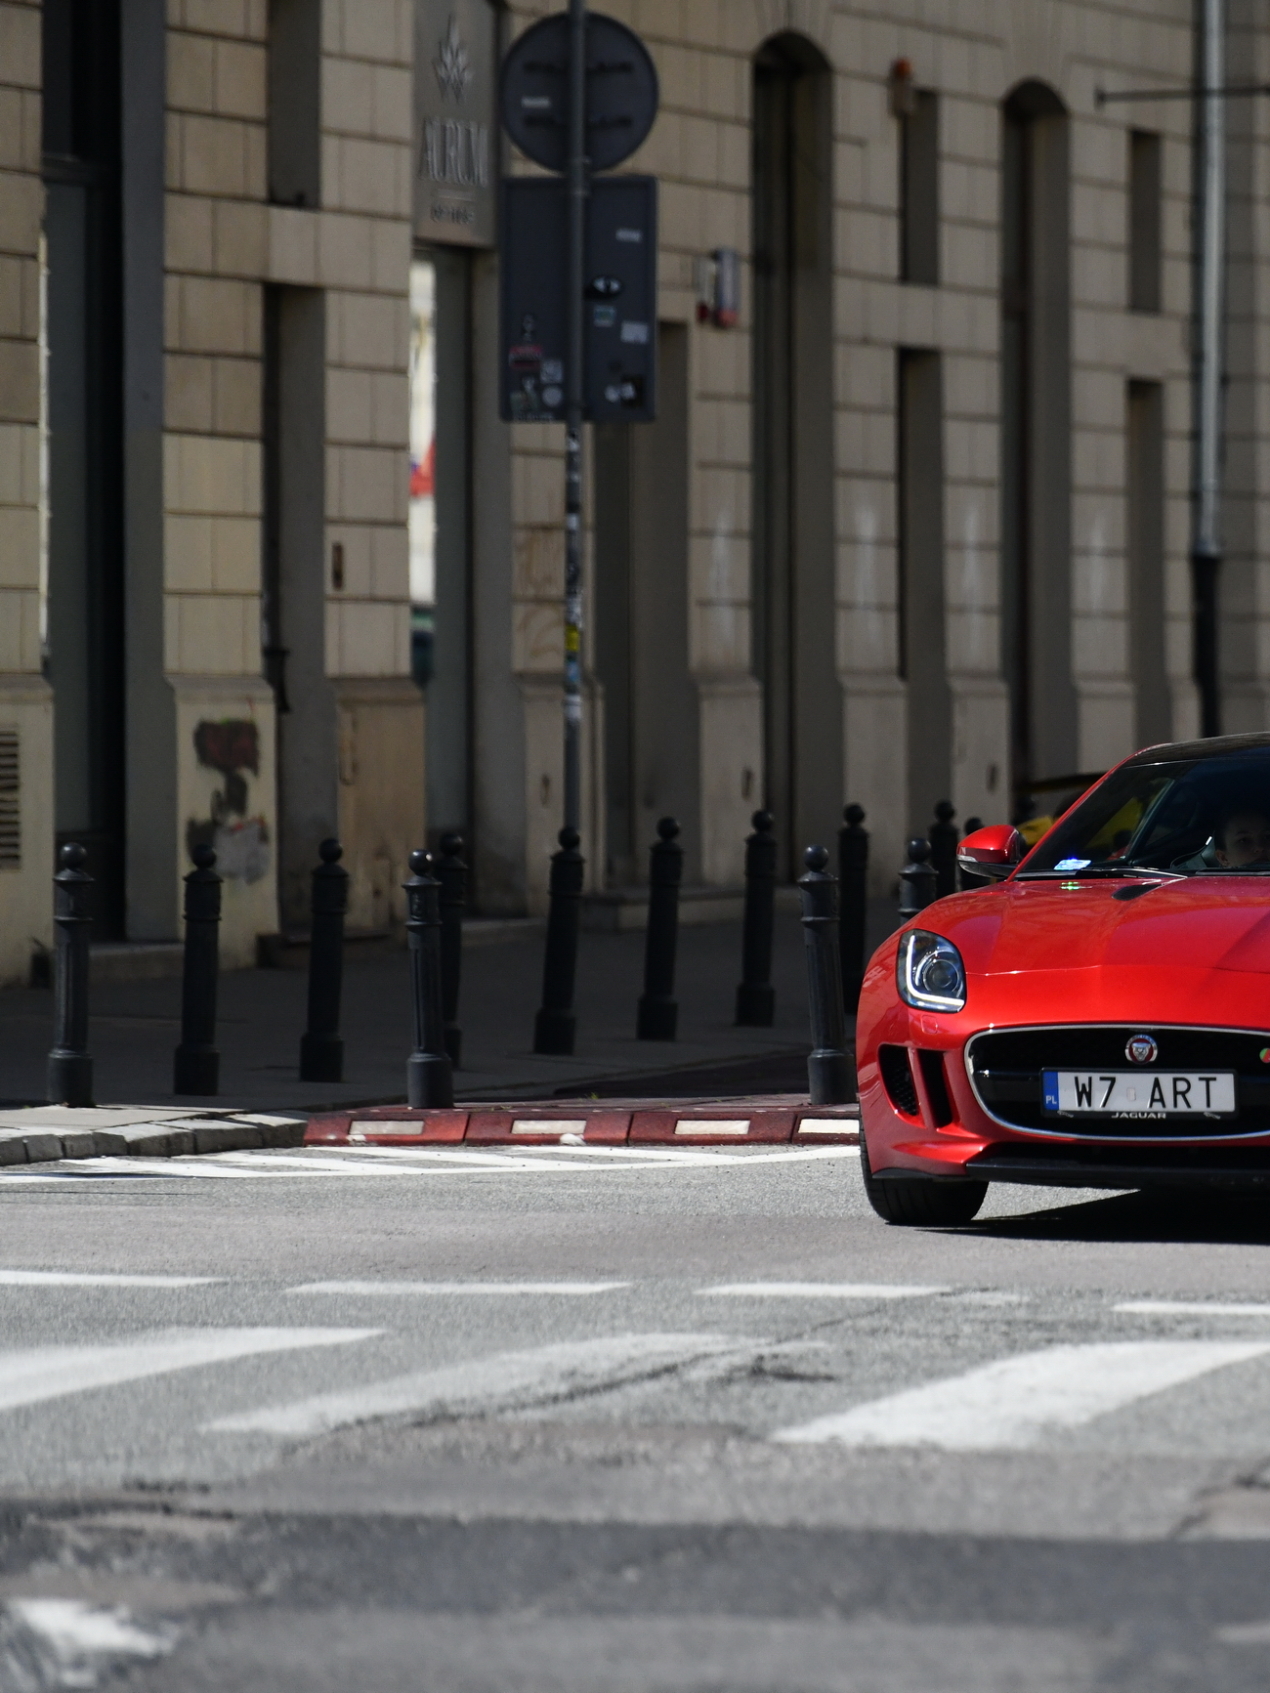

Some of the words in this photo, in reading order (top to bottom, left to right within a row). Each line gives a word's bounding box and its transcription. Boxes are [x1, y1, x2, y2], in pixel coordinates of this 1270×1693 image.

[1074, 1076, 1116, 1108] W7
[1149, 1076, 1217, 1109] ART
[1045, 1095, 1057, 1105] PL
[1111, 1112, 1167, 1120] JAGUAR
